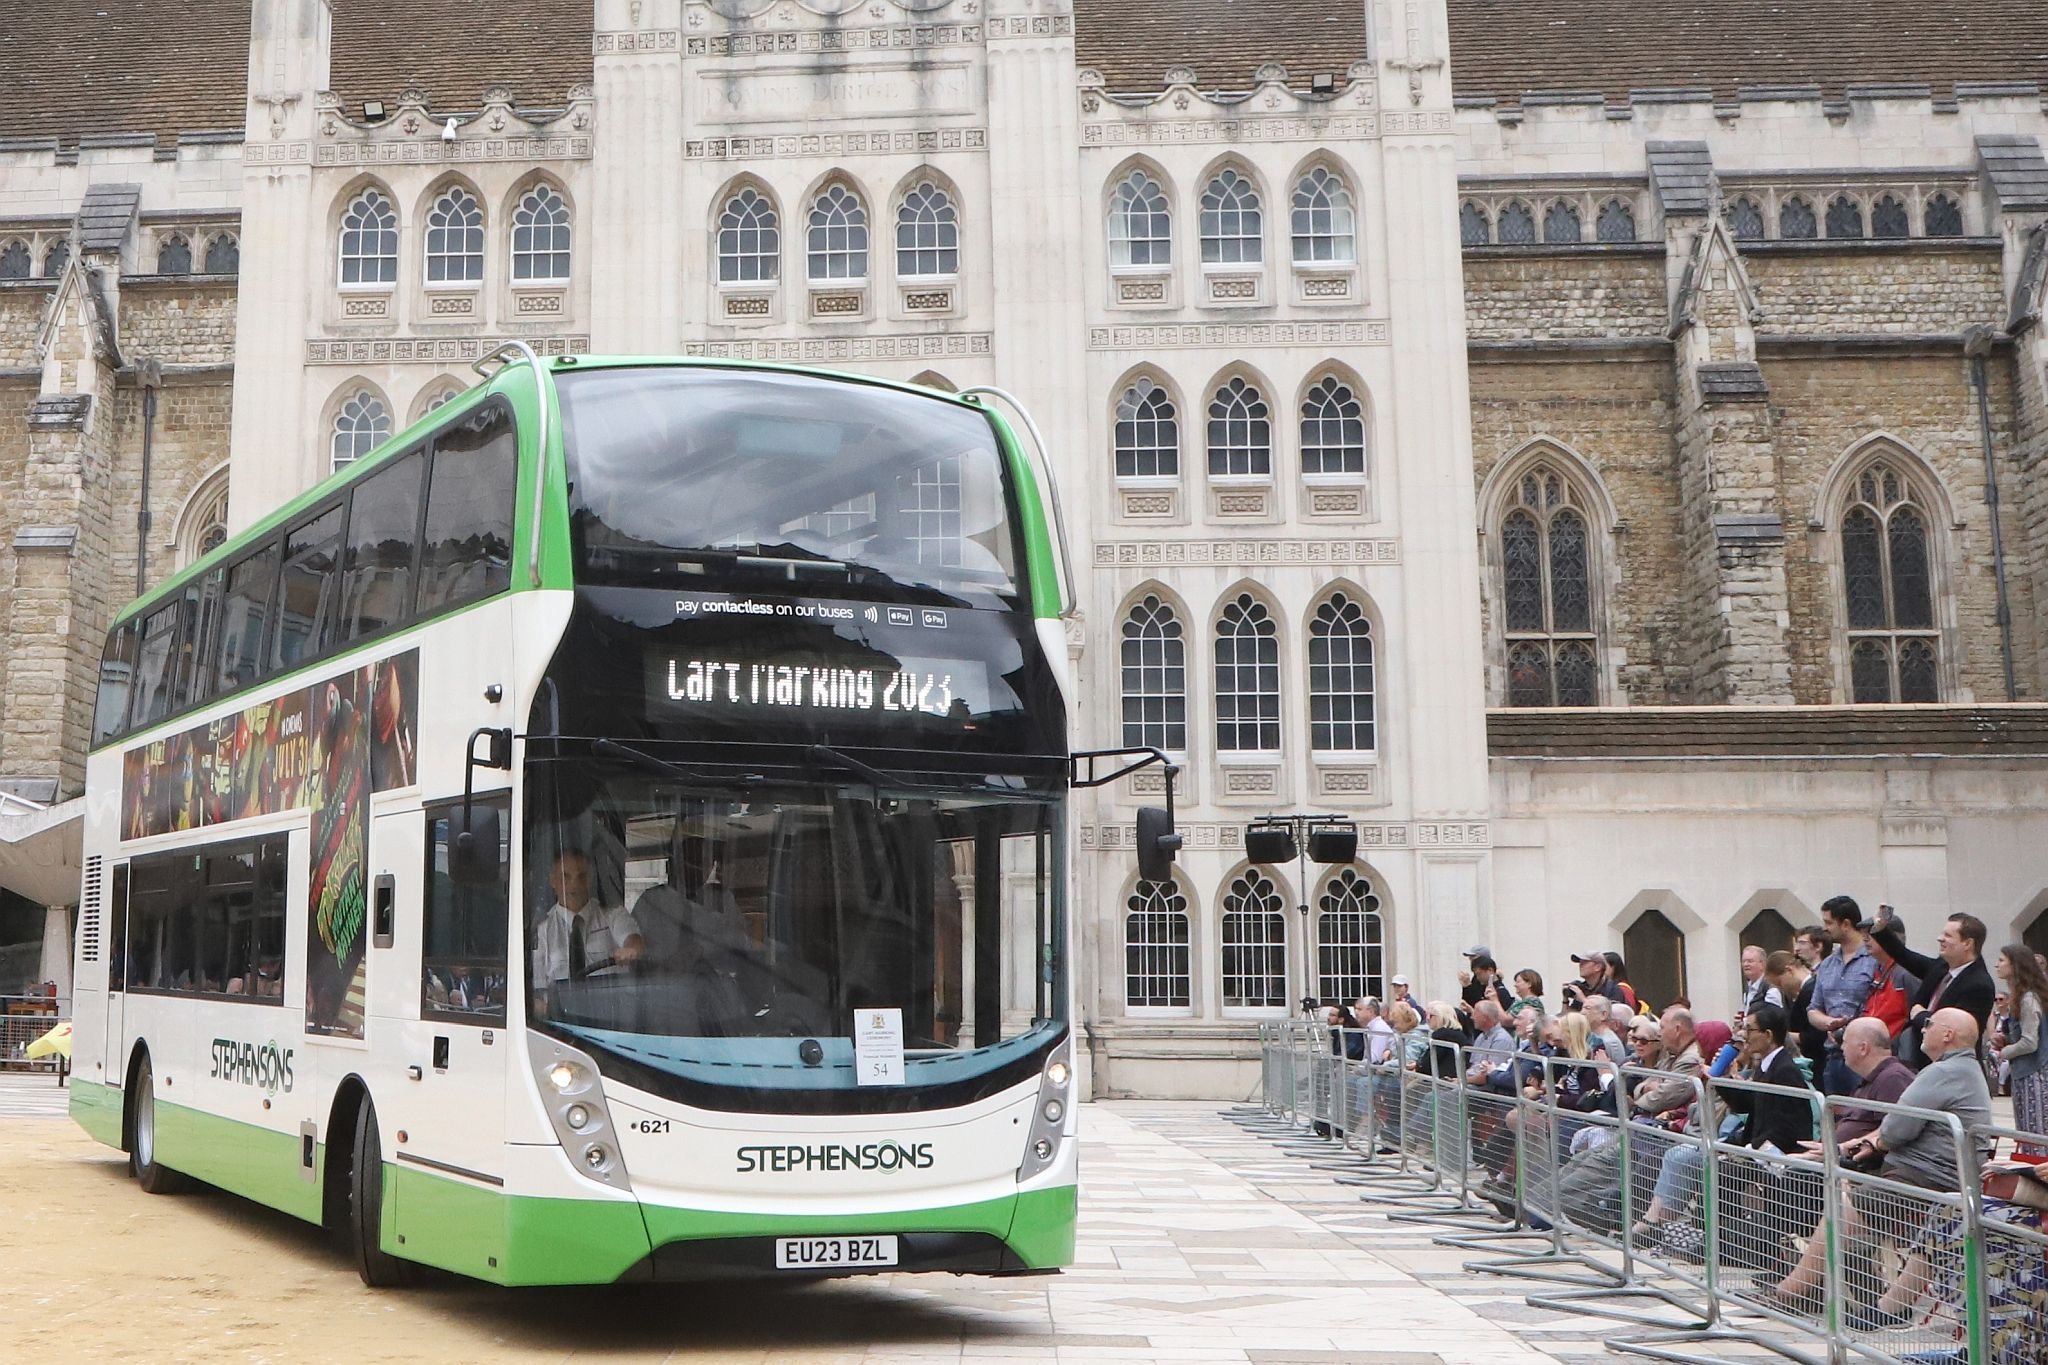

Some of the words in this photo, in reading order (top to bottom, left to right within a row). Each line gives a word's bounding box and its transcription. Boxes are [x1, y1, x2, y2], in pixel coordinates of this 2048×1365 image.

[675, 600, 700, 615] pay
[701, 599, 774, 616] contactless
[776, 605, 793, 616] on
[795, 605, 816, 617] our
[818, 603, 855, 619] buses
[883, 671, 951, 713] 2023
[273, 738, 297, 783] JULY
[298, 736, 309, 777] 31
[211, 1038, 294, 1094] STEPHENSONS
[873, 1064, 888, 1077] 54
[640, 1120, 670, 1133] 621
[737, 1143, 934, 1173] STEPHENSONS
[785, 1240, 842, 1263] EU23
[847, 1239, 889, 1262] BZL
